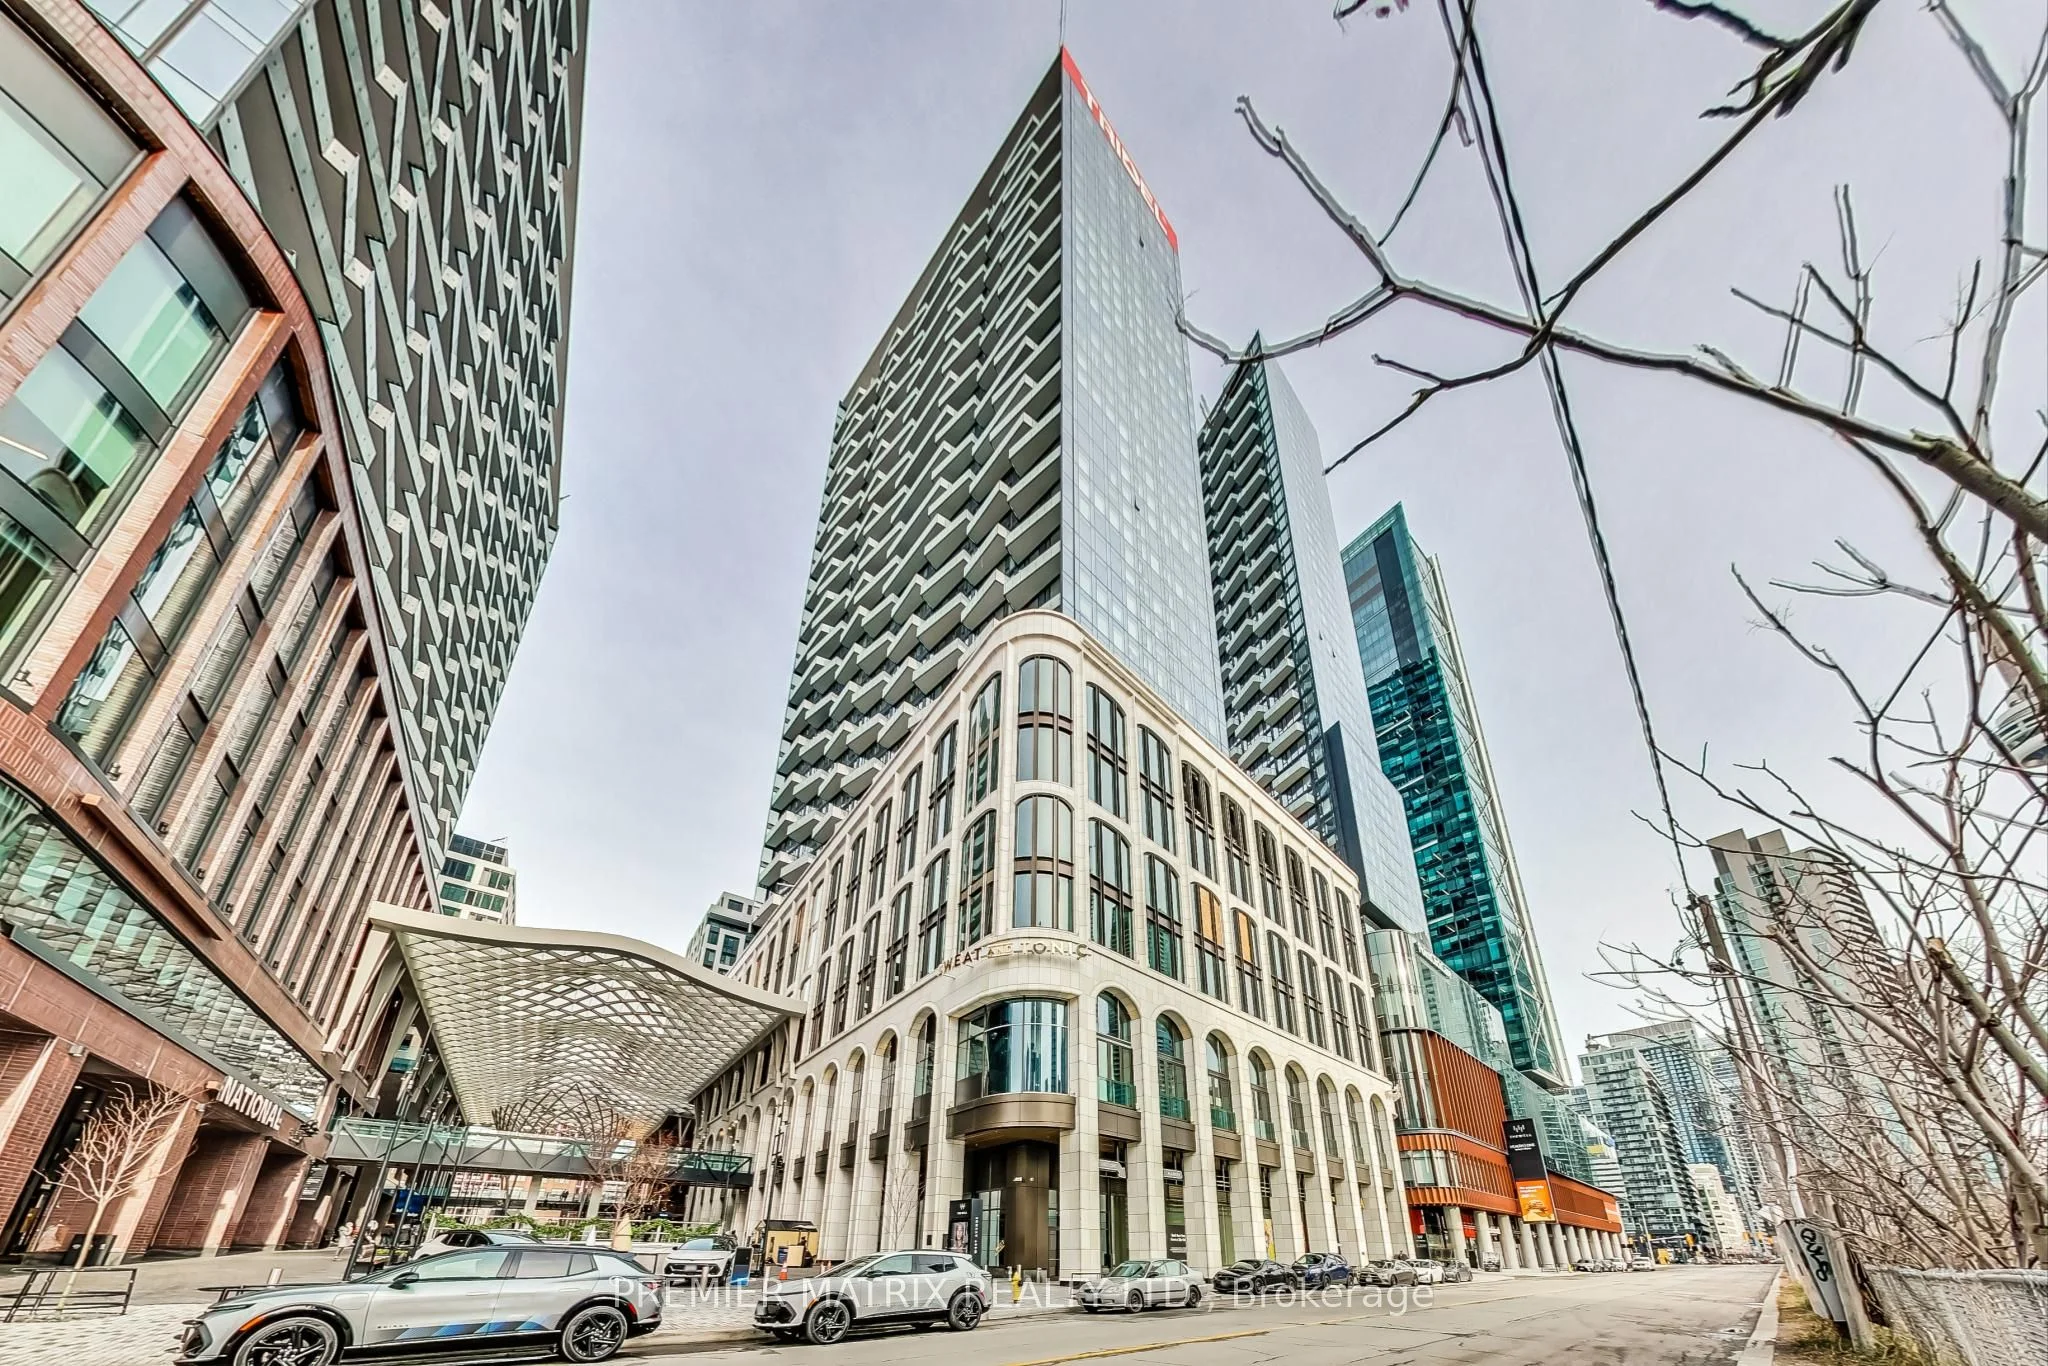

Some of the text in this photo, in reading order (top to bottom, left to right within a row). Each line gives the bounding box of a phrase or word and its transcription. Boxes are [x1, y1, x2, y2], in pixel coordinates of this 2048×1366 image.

[1080, 78, 1168, 236] TRIDEL
[1020, 942, 1087, 959] TONIC
[217, 1076, 283, 1131] NATIONAL
